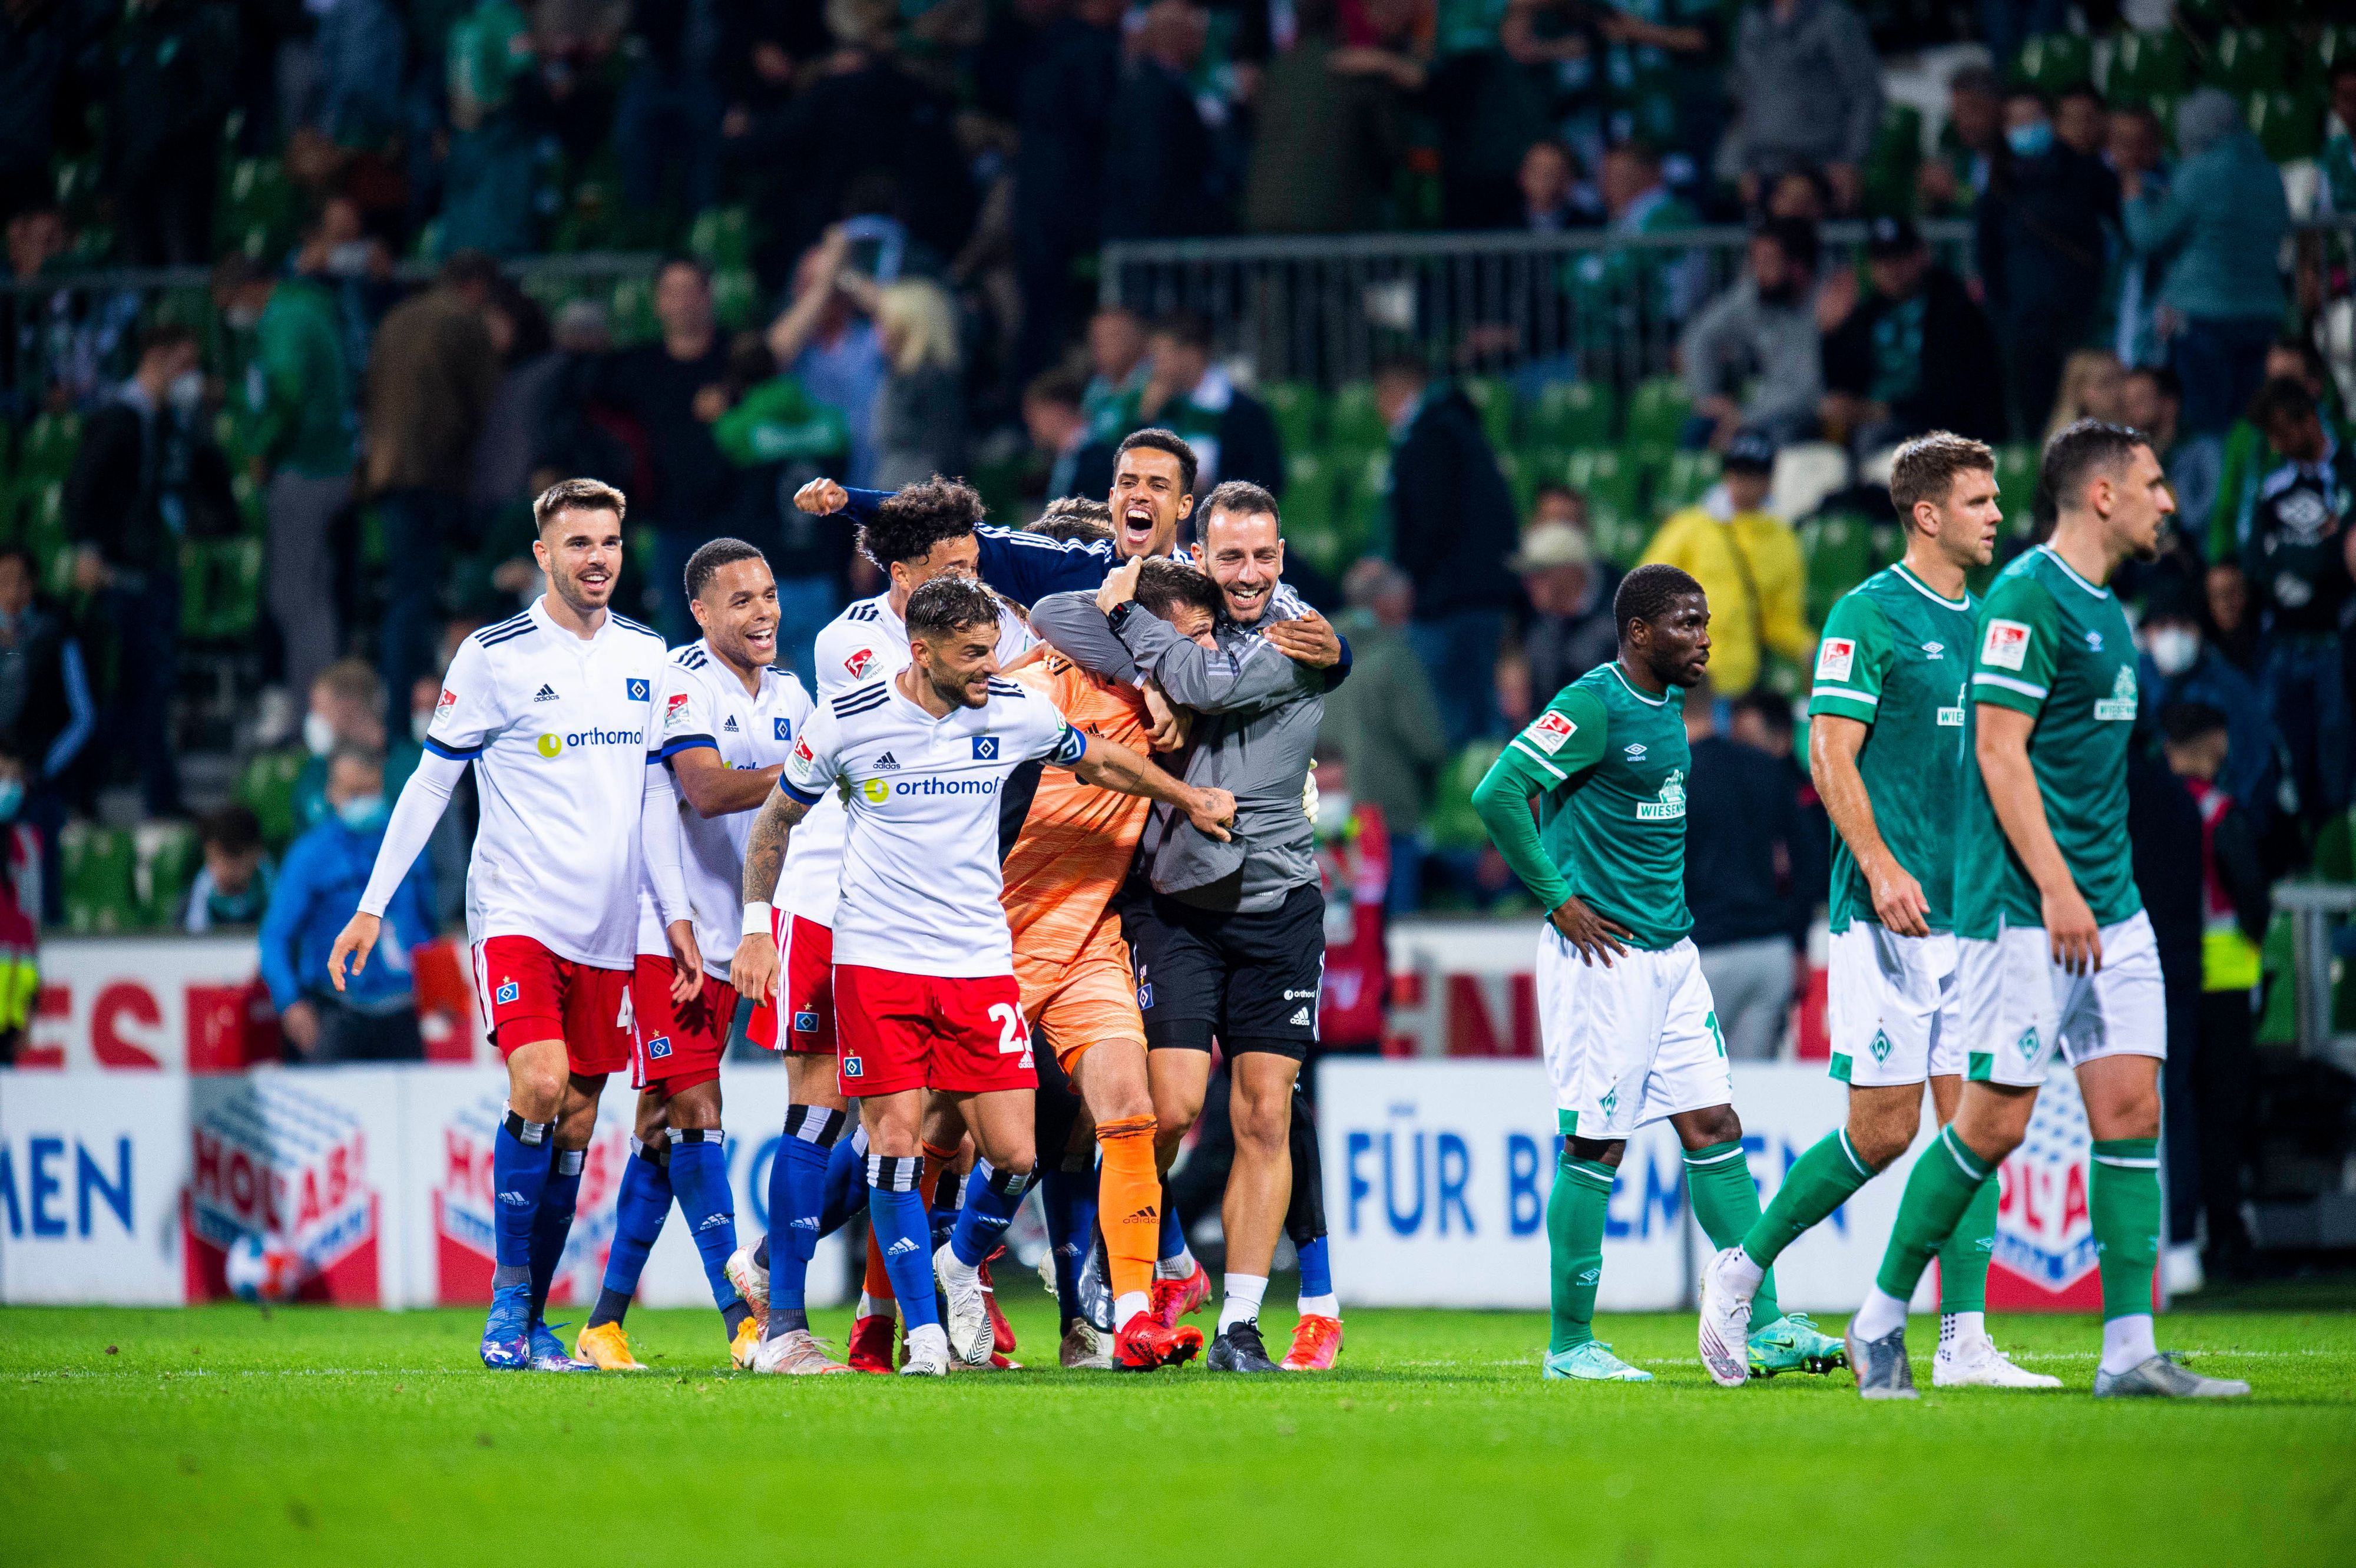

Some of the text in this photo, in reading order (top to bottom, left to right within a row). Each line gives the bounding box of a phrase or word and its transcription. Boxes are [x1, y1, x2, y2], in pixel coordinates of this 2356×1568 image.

[534, 694, 560, 702] adidas
[567, 726, 644, 747] orthomol
[896, 776, 1000, 795] orthomol
[616, 985, 633, 1035] 4
[1346, 1101, 1477, 1238] FÜR
[498, 1194, 530, 1206] adidas
[700, 1218, 730, 1230] adidas
[887, 1243, 920, 1256] adidas
